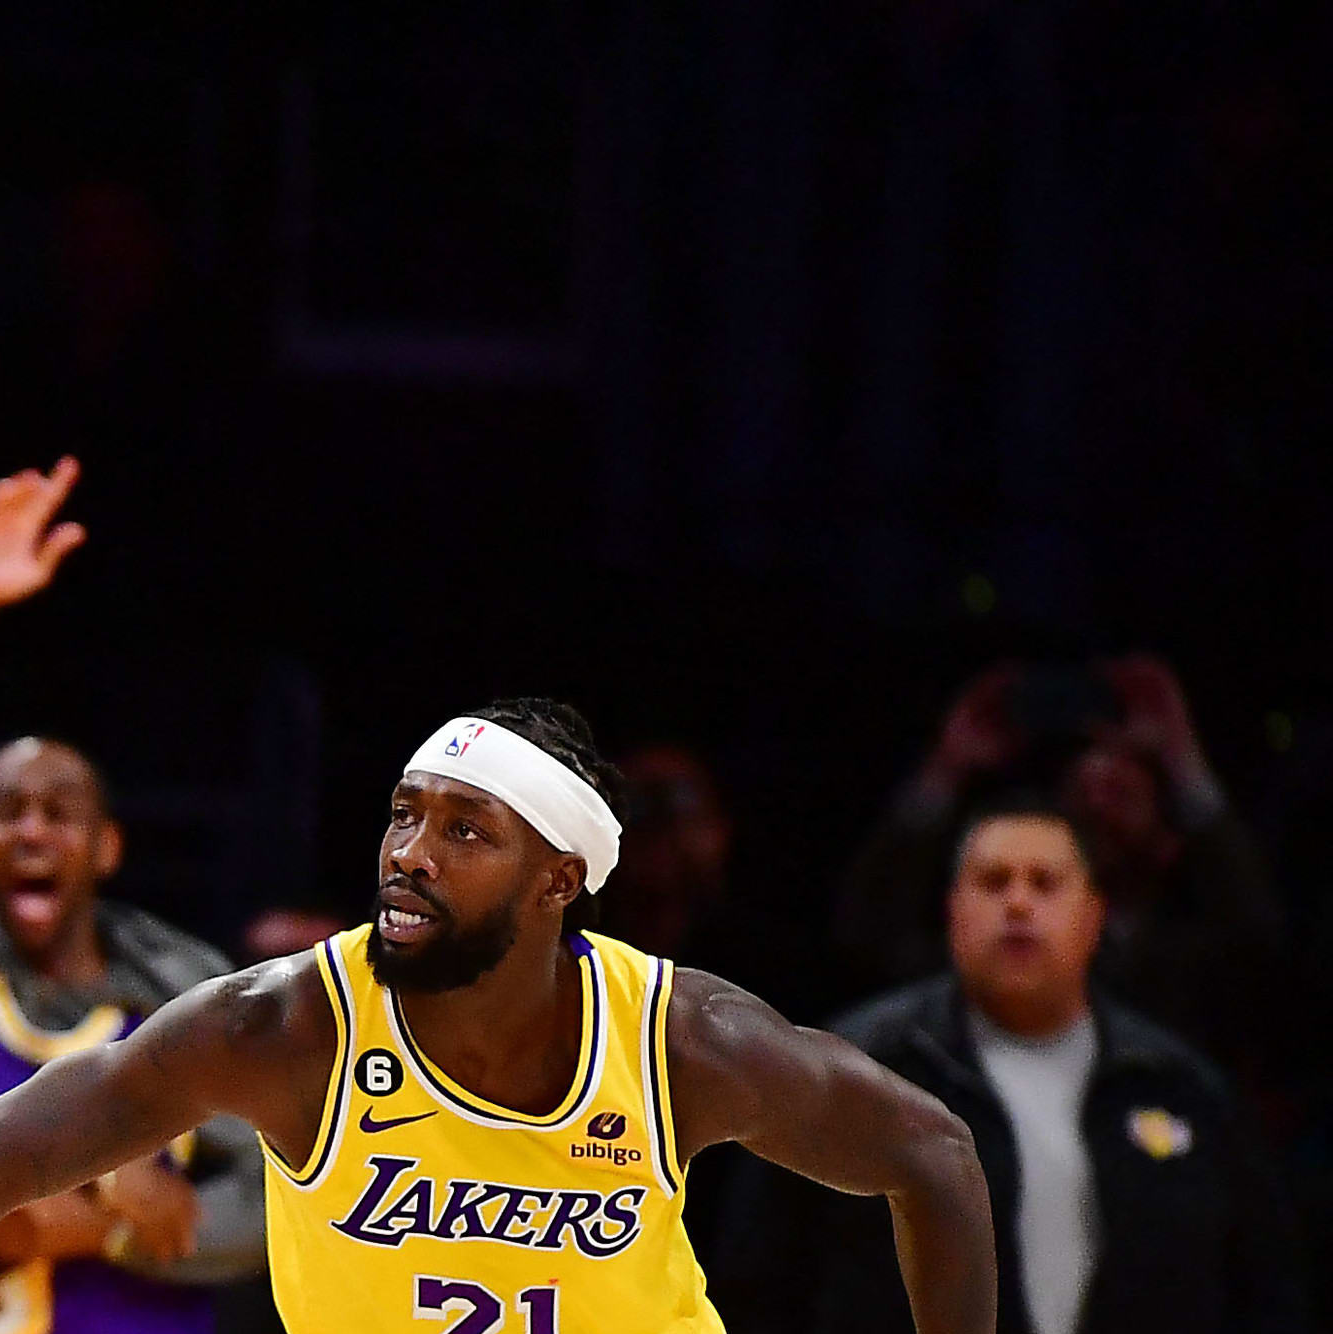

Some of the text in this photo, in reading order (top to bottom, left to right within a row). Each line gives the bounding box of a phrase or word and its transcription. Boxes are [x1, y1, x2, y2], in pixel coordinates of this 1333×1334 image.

[366, 1055, 393, 1092] 6
[571, 1143, 642, 1166] bibigo
[331, 1154, 648, 1260] LAKERS
